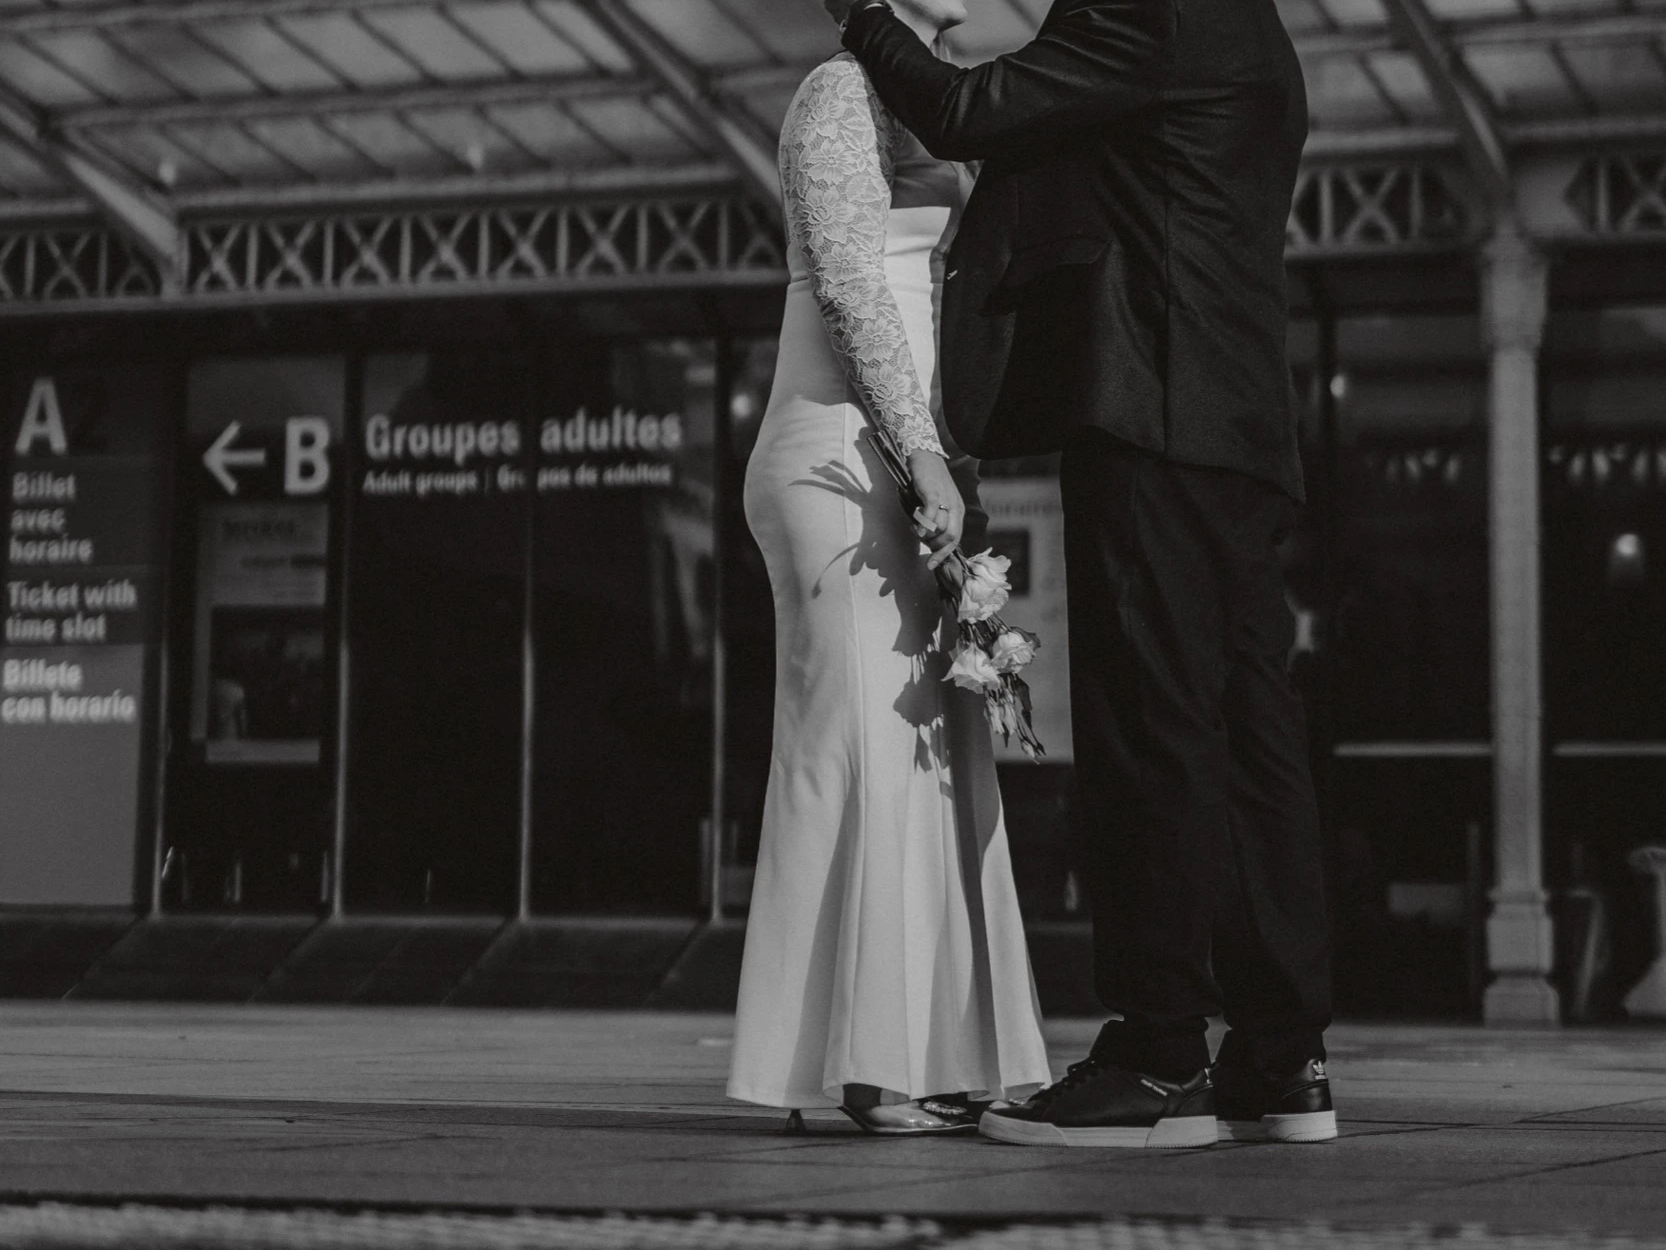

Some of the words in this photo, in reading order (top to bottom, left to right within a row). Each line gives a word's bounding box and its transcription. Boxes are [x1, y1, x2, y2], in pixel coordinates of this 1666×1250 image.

[15, 377, 68, 457] A
[365, 414, 520, 467] Groupes
[540, 405, 682, 453] adultes
[284, 416, 331, 494] B
[12, 470, 77, 503] Billet
[10, 508, 66, 533] avec
[8, 533, 94, 564] horaire
[7, 580, 79, 611] Ticket
[83, 578, 138, 610] with
[5, 613, 57, 642] time
[61, 611, 107, 642] slot
[3, 658, 83, 691] Billete
[1, 696, 47, 723] con
[50, 689, 137, 723] horario
